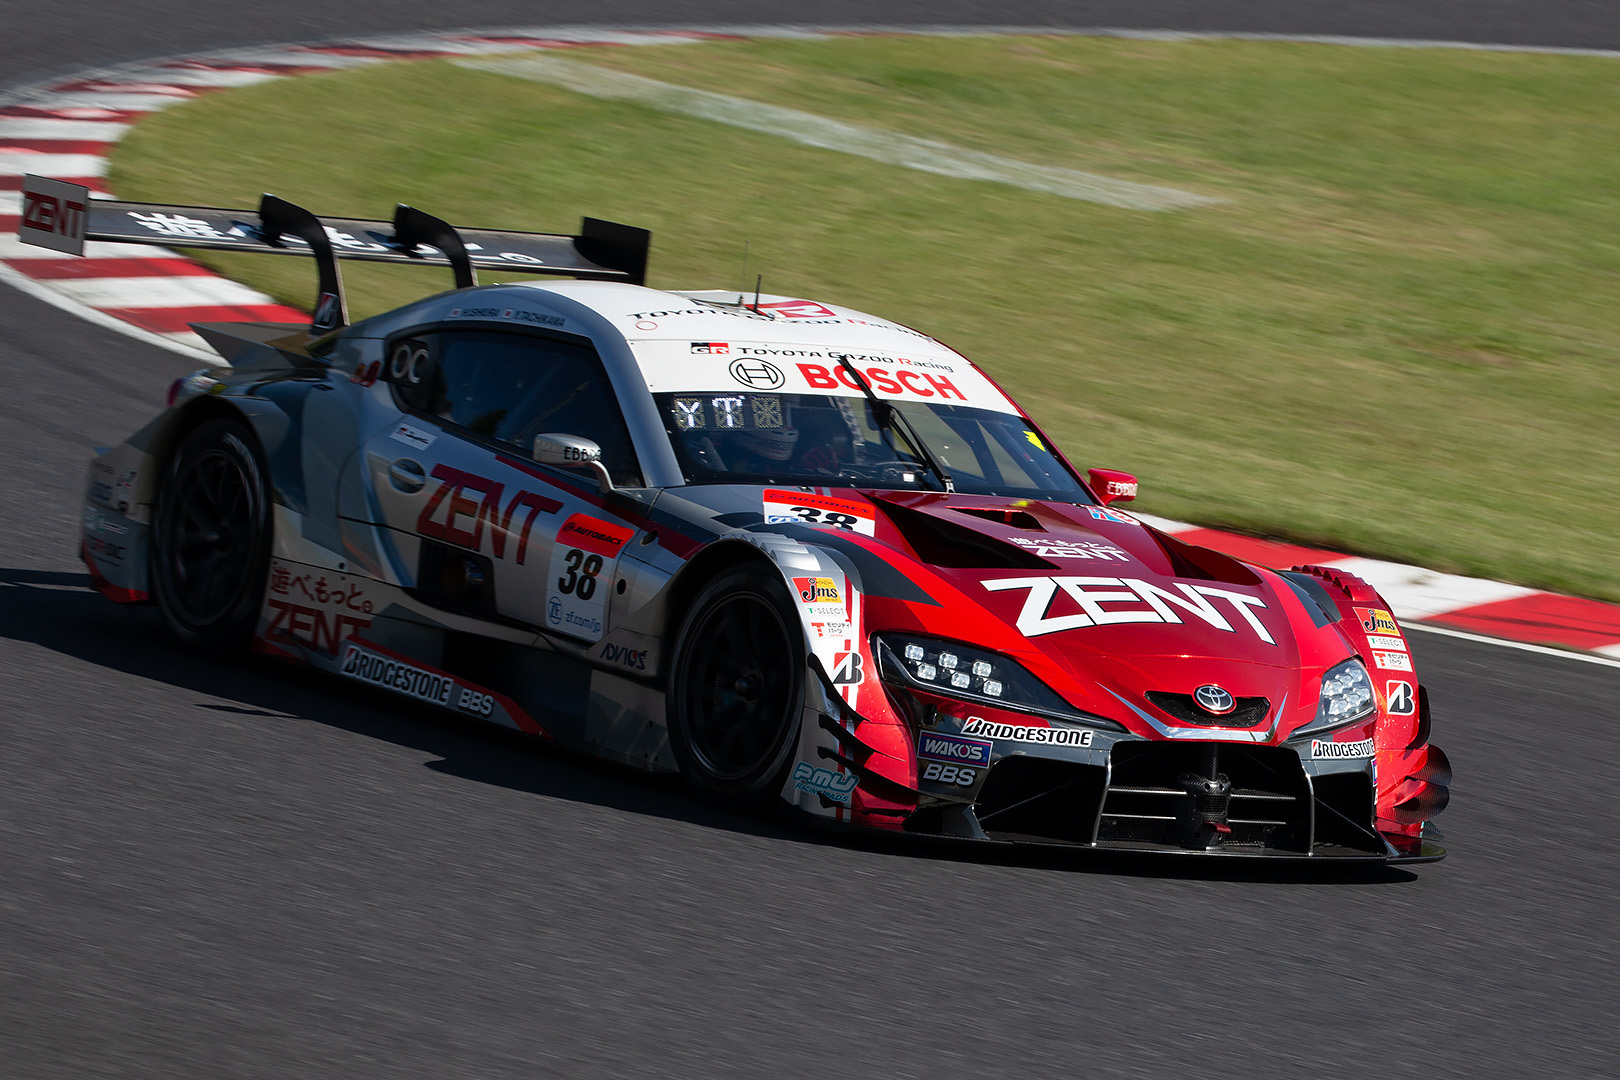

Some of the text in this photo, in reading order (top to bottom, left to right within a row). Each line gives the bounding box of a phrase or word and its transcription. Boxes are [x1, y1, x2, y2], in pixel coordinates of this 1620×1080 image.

[24, 191, 85, 239] ZENT
[737, 347, 822, 358] TOYOTA
[898, 357, 955, 374] Racing
[796, 362, 968, 402] BOSCH
[417, 462, 565, 566] ZENT
[790, 506, 858, 530] 38
[572, 526, 625, 546] AUTOBACS
[1021, 544, 1131, 562] ZENT
[558, 549, 604, 600] 38
[565, 611, 602, 634] zf.com/jp
[980, 576, 1278, 647] ZENT
[264, 598, 372, 656] ZENT
[344, 647, 452, 703] BRIDGESTONE
[457, 688, 494, 716] BBS
[962, 717, 1091, 746] BRIDGESTONE
[923, 763, 977, 786] BBS
